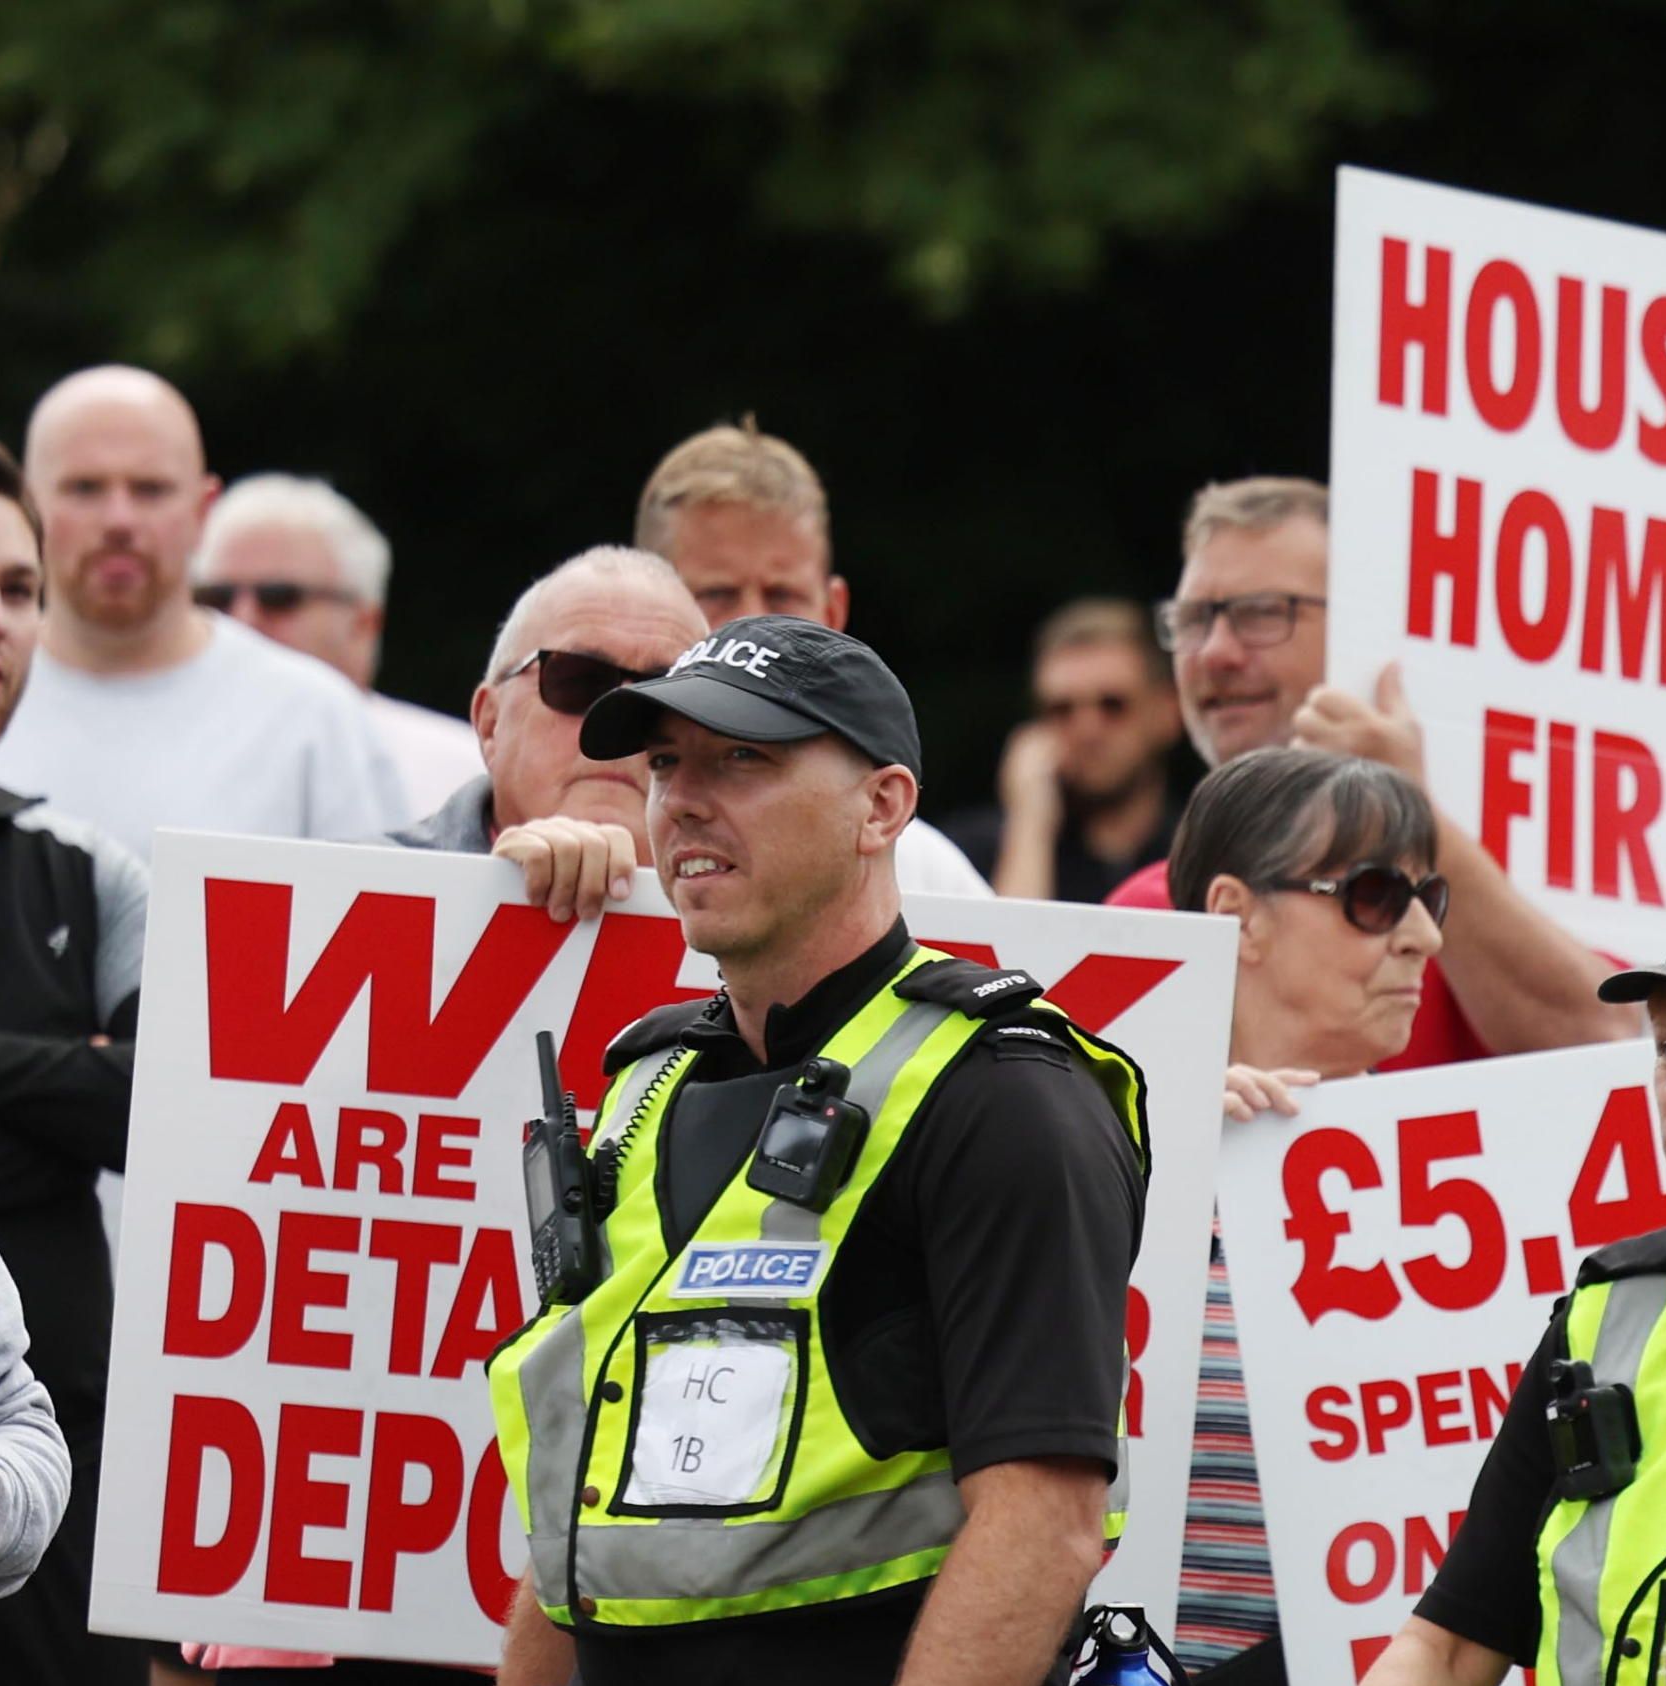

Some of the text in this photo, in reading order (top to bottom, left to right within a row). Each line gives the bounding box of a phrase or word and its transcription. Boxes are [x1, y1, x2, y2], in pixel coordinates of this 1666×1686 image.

[247, 1101, 481, 1201] ARE
[162, 1201, 525, 1379] DETA
[688, 1253, 814, 1283] POLICE
[682, 1362, 736, 1405] HC
[1305, 1362, 1521, 1462] SPEN
[671, 1434, 706, 1474] 1B
